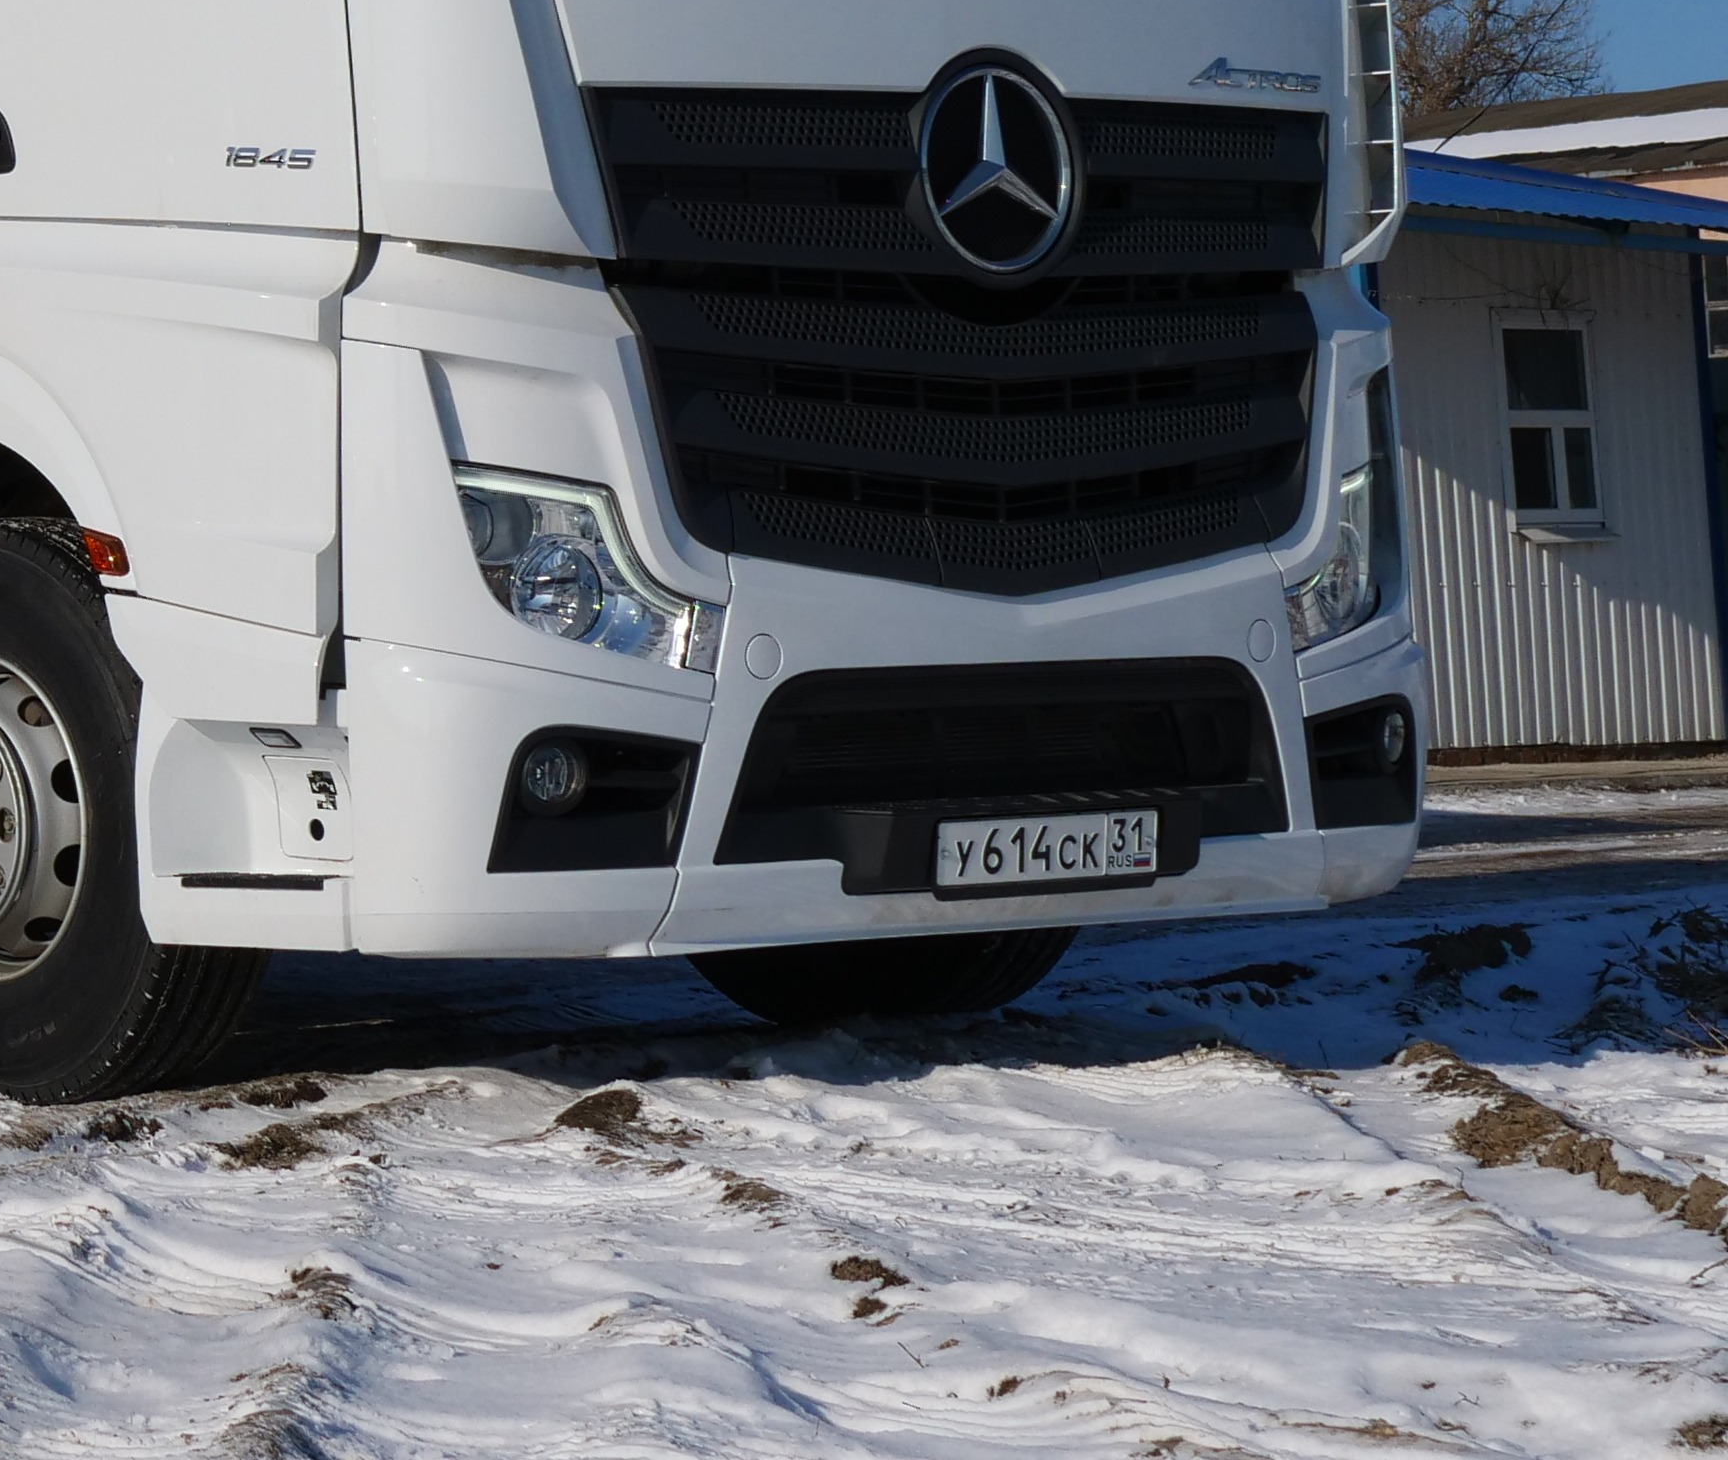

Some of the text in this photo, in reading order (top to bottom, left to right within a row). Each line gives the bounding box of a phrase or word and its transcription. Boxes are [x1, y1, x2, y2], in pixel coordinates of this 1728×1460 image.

[225, 146, 316, 170] 1845
[1112, 817, 1143, 853] 31
[1108, 853, 1132, 869] RUS
